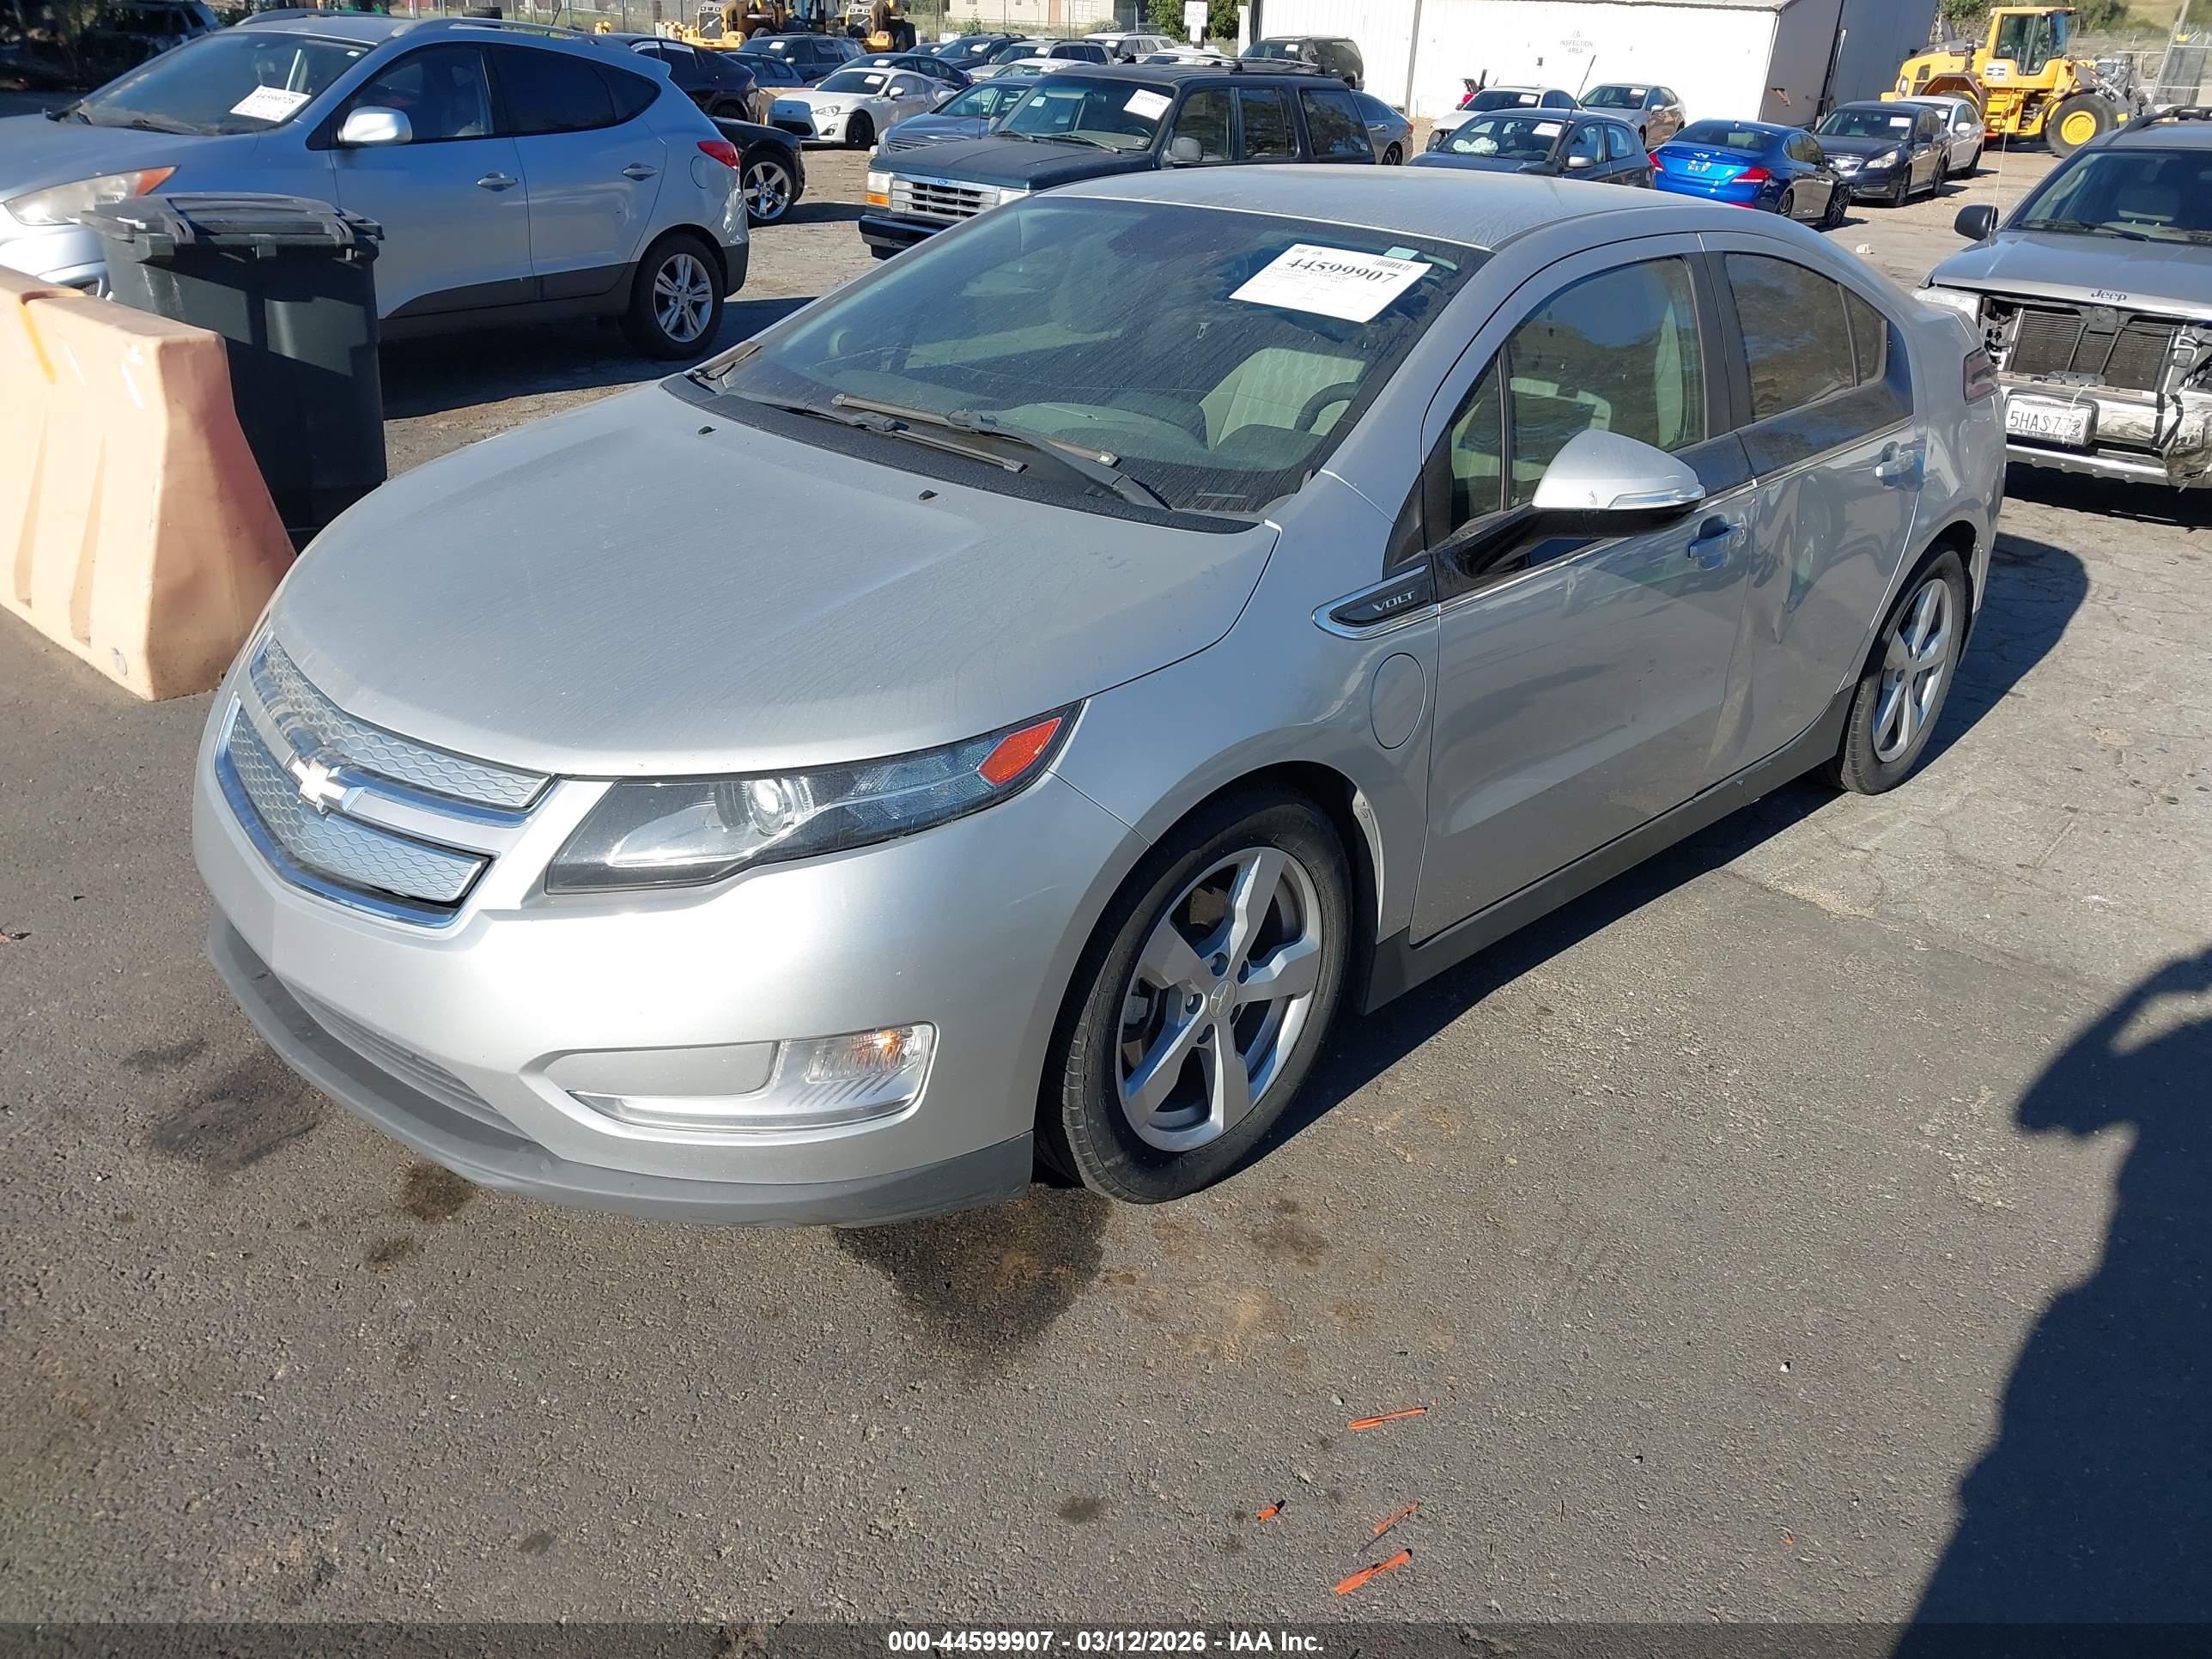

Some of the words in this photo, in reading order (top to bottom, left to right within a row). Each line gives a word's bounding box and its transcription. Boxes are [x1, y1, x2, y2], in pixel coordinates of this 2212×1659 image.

[1286, 258, 1401, 284] 44599907
[2091, 289, 2128, 303] Jeep
[1372, 590, 1416, 611] VOLT
